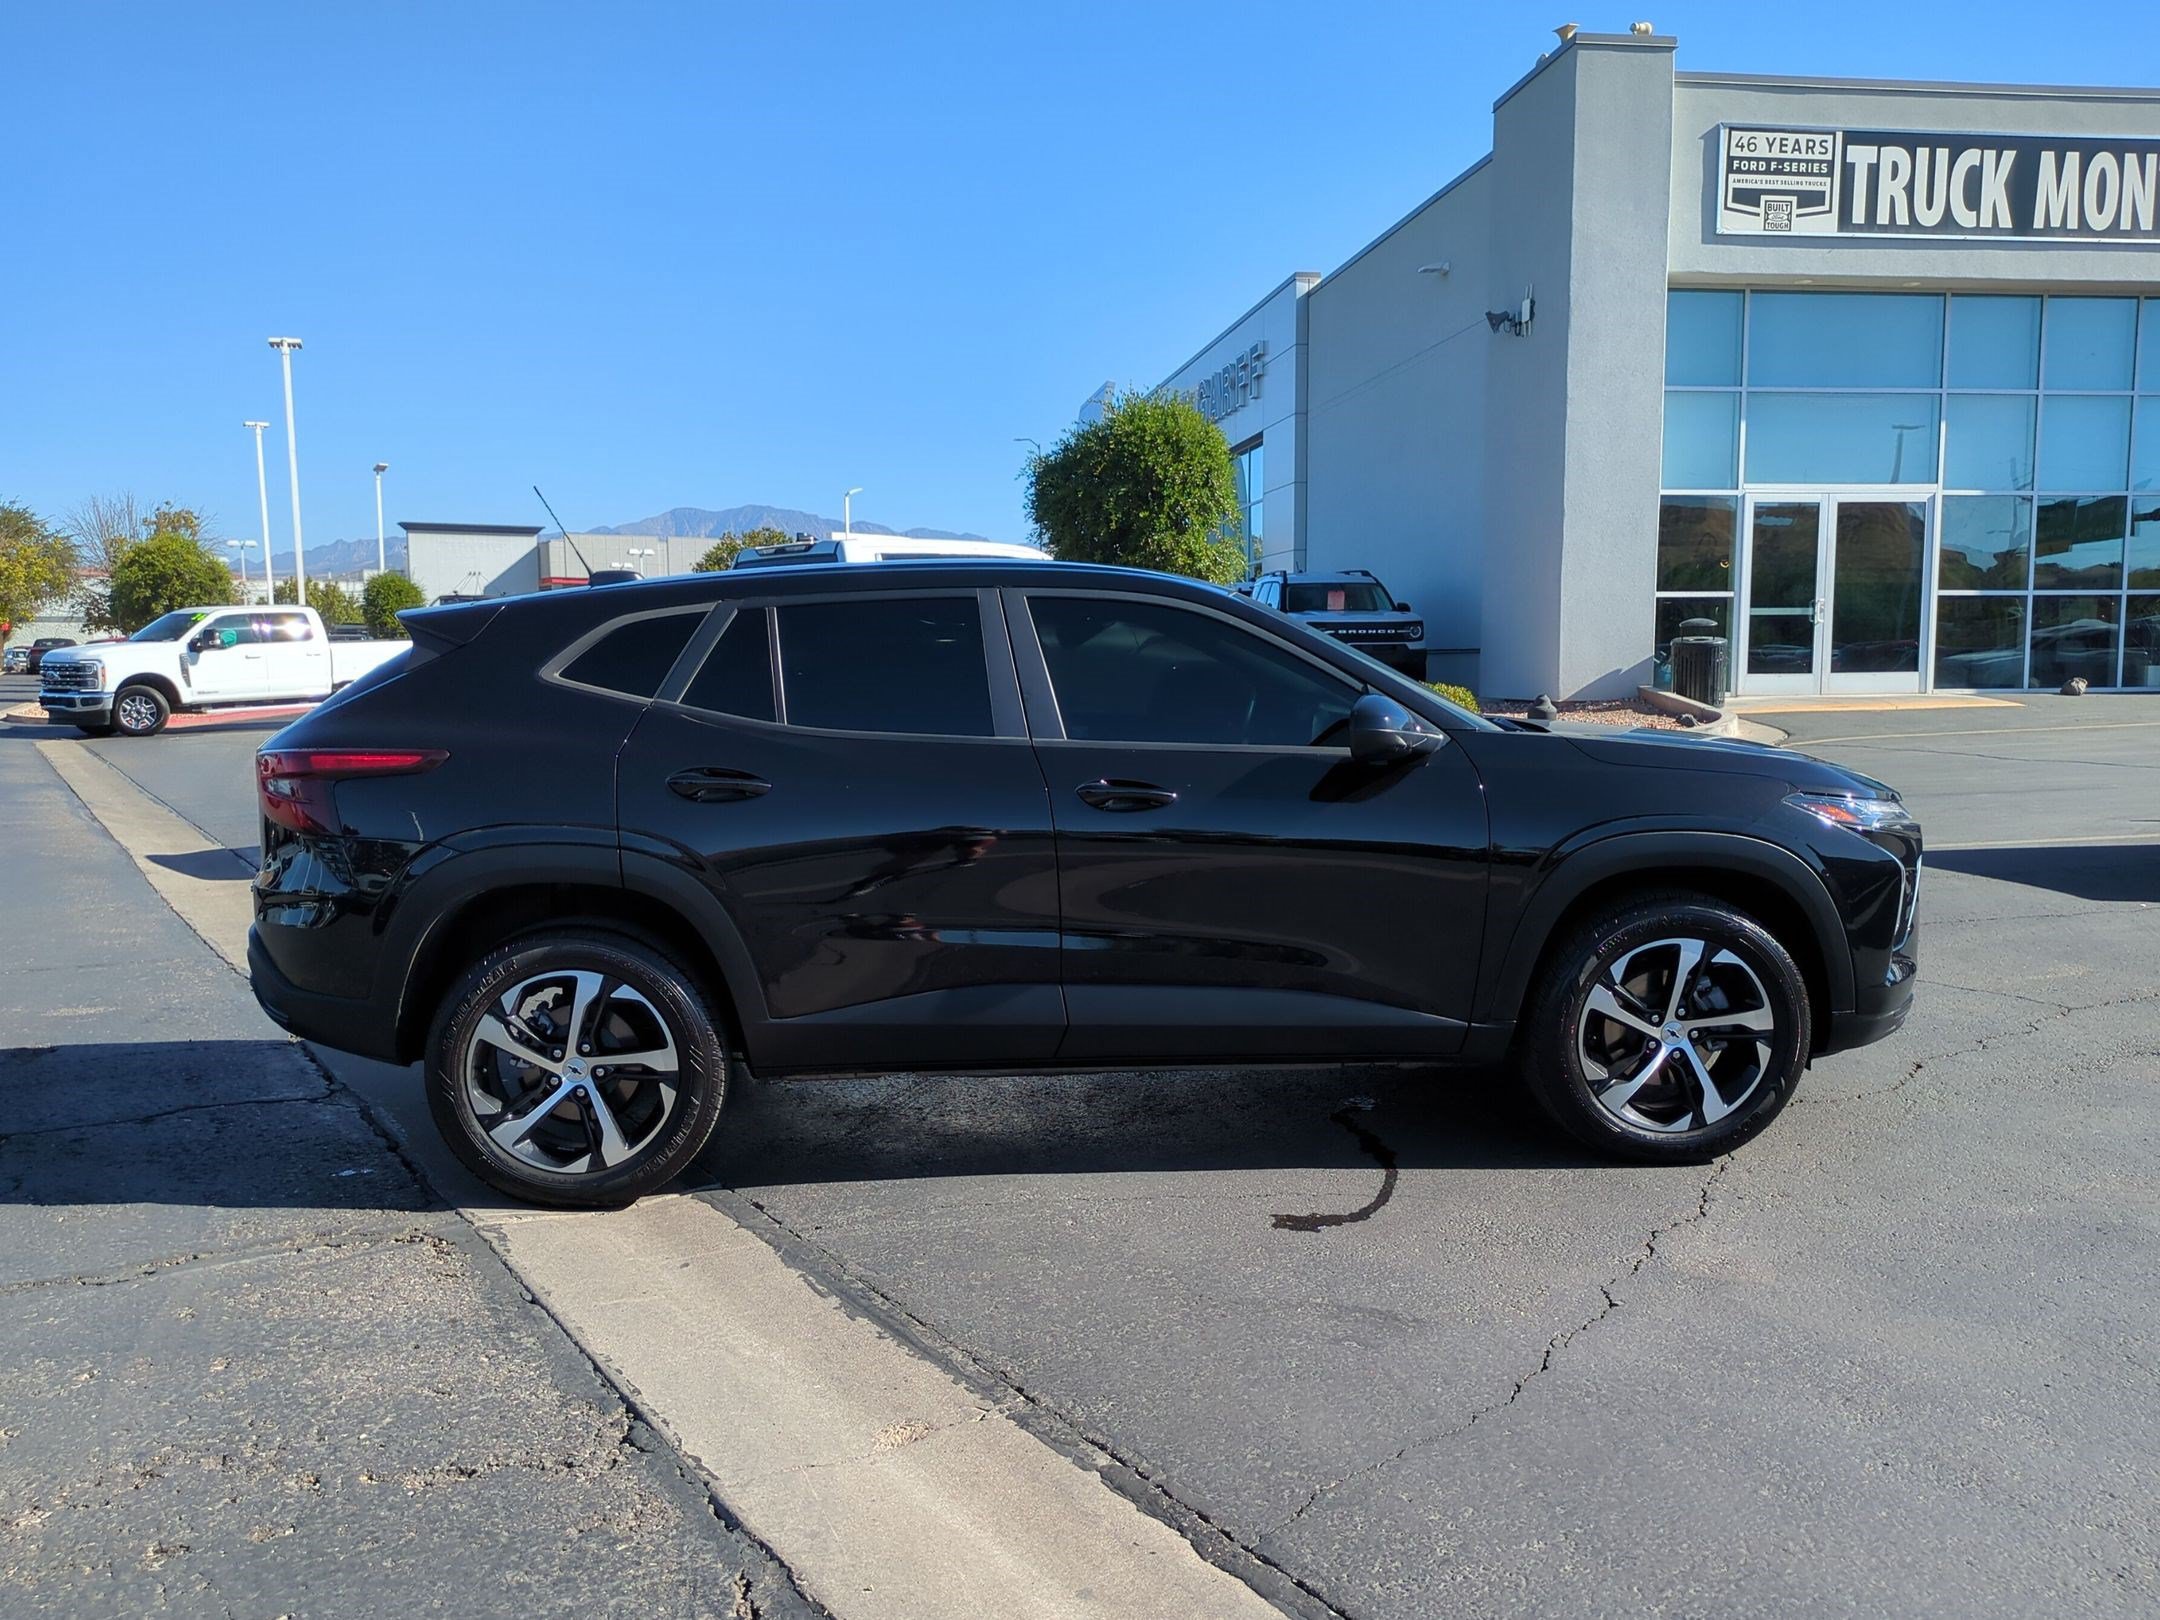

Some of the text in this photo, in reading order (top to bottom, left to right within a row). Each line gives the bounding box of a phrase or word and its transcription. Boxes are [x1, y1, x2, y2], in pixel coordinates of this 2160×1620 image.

[1735, 136, 1829, 155] 46 YEARS
[1733, 160, 1828, 173] FORD F-SERIES
[1846, 145, 2160, 231] TRUCK MON
[1767, 203, 1790, 212] BUILT
